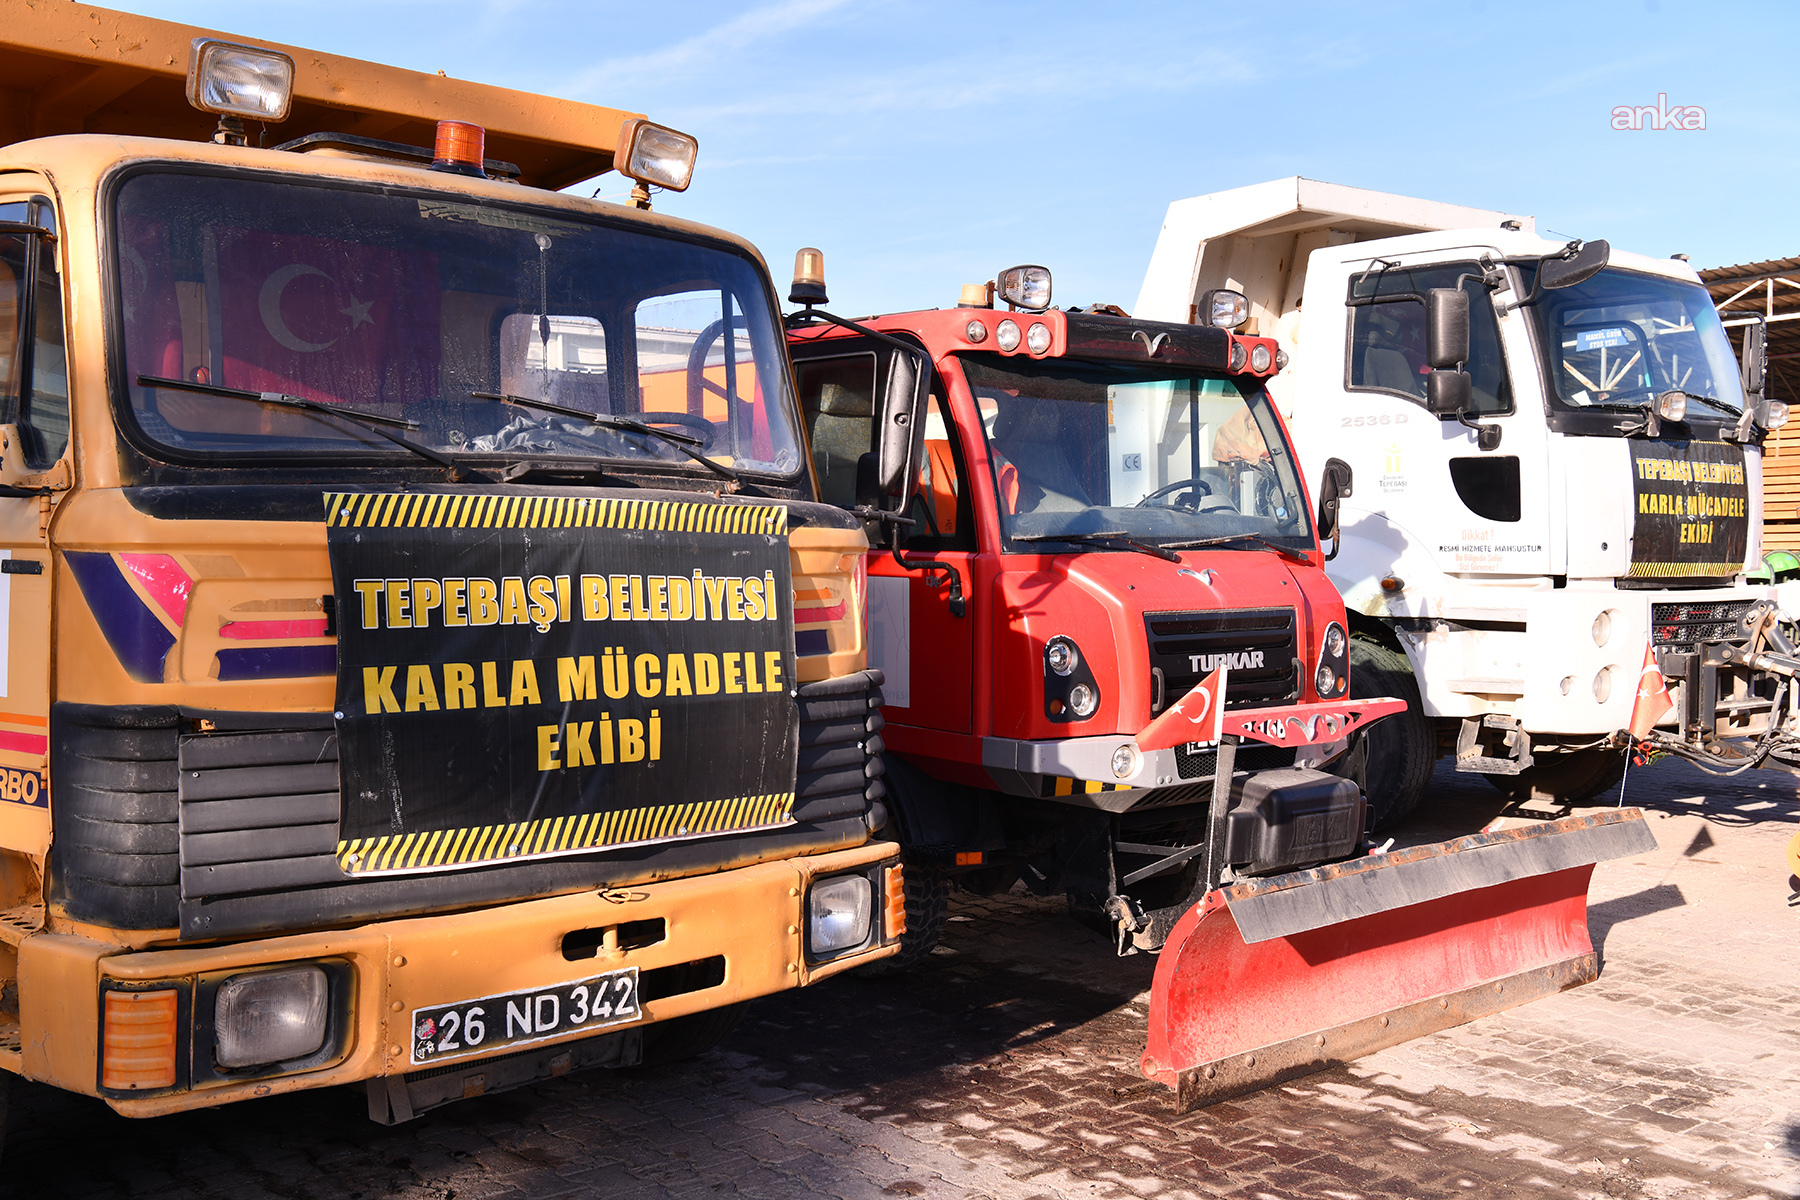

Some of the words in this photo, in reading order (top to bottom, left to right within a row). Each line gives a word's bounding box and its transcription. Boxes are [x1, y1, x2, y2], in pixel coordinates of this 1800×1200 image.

[1341, 415, 1391, 427] 2536
[1395, 413, 1409, 424] D
[1636, 458, 1693, 485] TEPEBAŞI
[1692, 460, 1744, 485] BELEDİYESİ
[1639, 494, 1684, 515] KARLA
[1686, 493, 1744, 517] MÜCADELE
[1461, 529, 1488, 541] Dikkat
[1680, 521, 1713, 543] EKİBİ
[353, 575, 571, 633] TEPEBAŞI
[580, 568, 777, 622] BELEDİYESİ
[1189, 651, 1264, 673] TURKAR
[363, 659, 541, 715] KARLA
[556, 646, 784, 702] MÜCADELE
[537, 709, 662, 771] EKİBİ
[438, 1007, 485, 1051] 26
[506, 994, 560, 1038] ND
[569, 977, 635, 1024] 342
